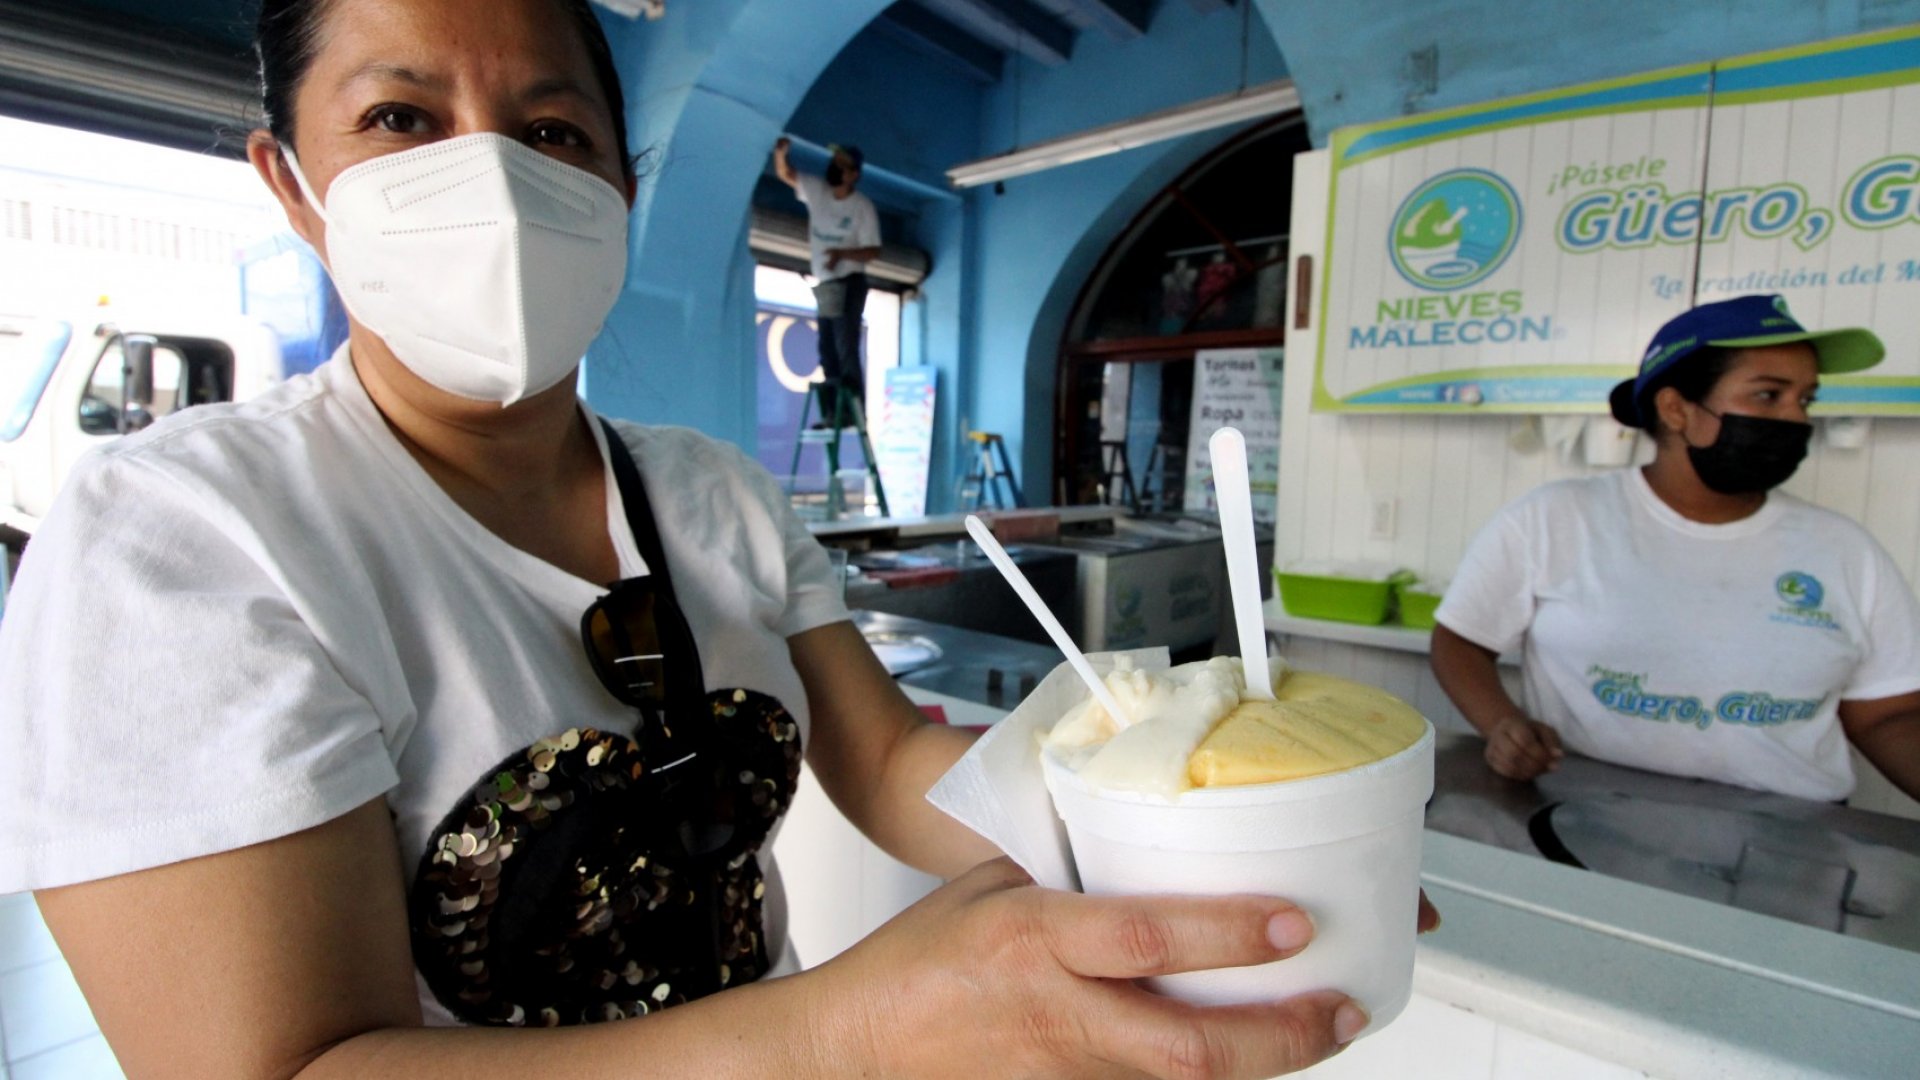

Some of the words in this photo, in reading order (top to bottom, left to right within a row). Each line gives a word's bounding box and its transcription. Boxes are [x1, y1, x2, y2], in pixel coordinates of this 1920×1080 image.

[1547, 155, 1667, 195] ¡Pásele
[1559, 185, 1829, 250] Güero,
[1694, 266, 1828, 293] radición
[1837, 262, 1886, 286] del
[1377, 290, 1523, 323] NIEVES
[1350, 312, 1551, 349] MALECÓN
[1201, 406, 1245, 426] Ropa
[1592, 679, 1714, 730] Güero,
